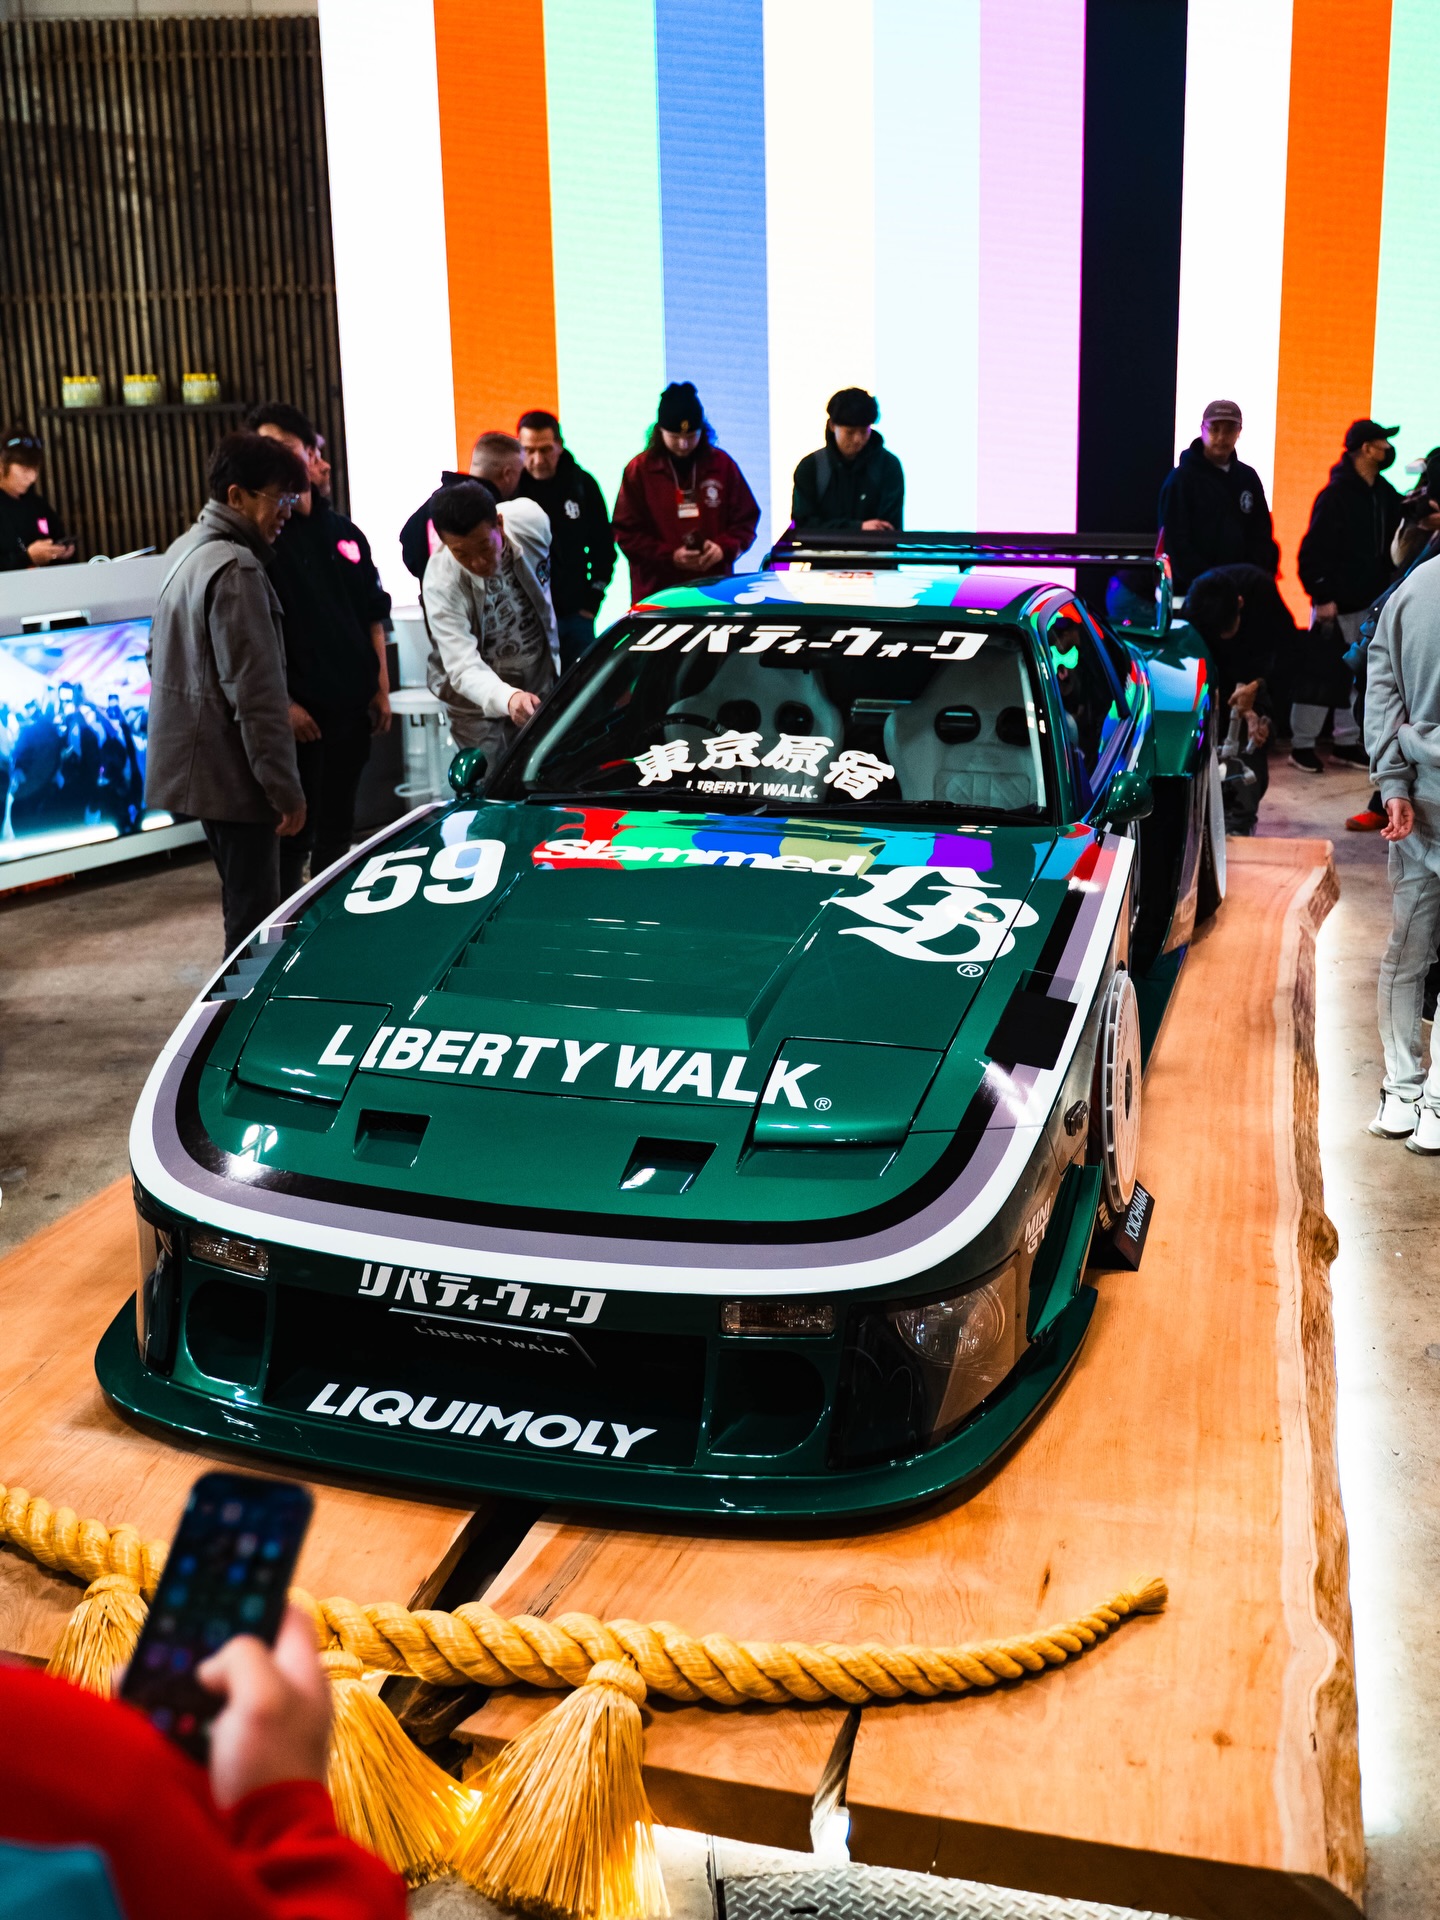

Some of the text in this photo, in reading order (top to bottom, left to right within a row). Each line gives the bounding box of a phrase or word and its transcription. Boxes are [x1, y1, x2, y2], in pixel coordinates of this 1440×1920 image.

[344, 839, 507, 914] 59
[544, 839, 867, 876] Slammed
[317, 1025, 606, 1082] LIBERTY
[1025, 1197, 1051, 1243] MINI
[1124, 1186, 1149, 1242] YOKOHAMA
[414, 1326, 570, 1356] LIBERTY WALK
